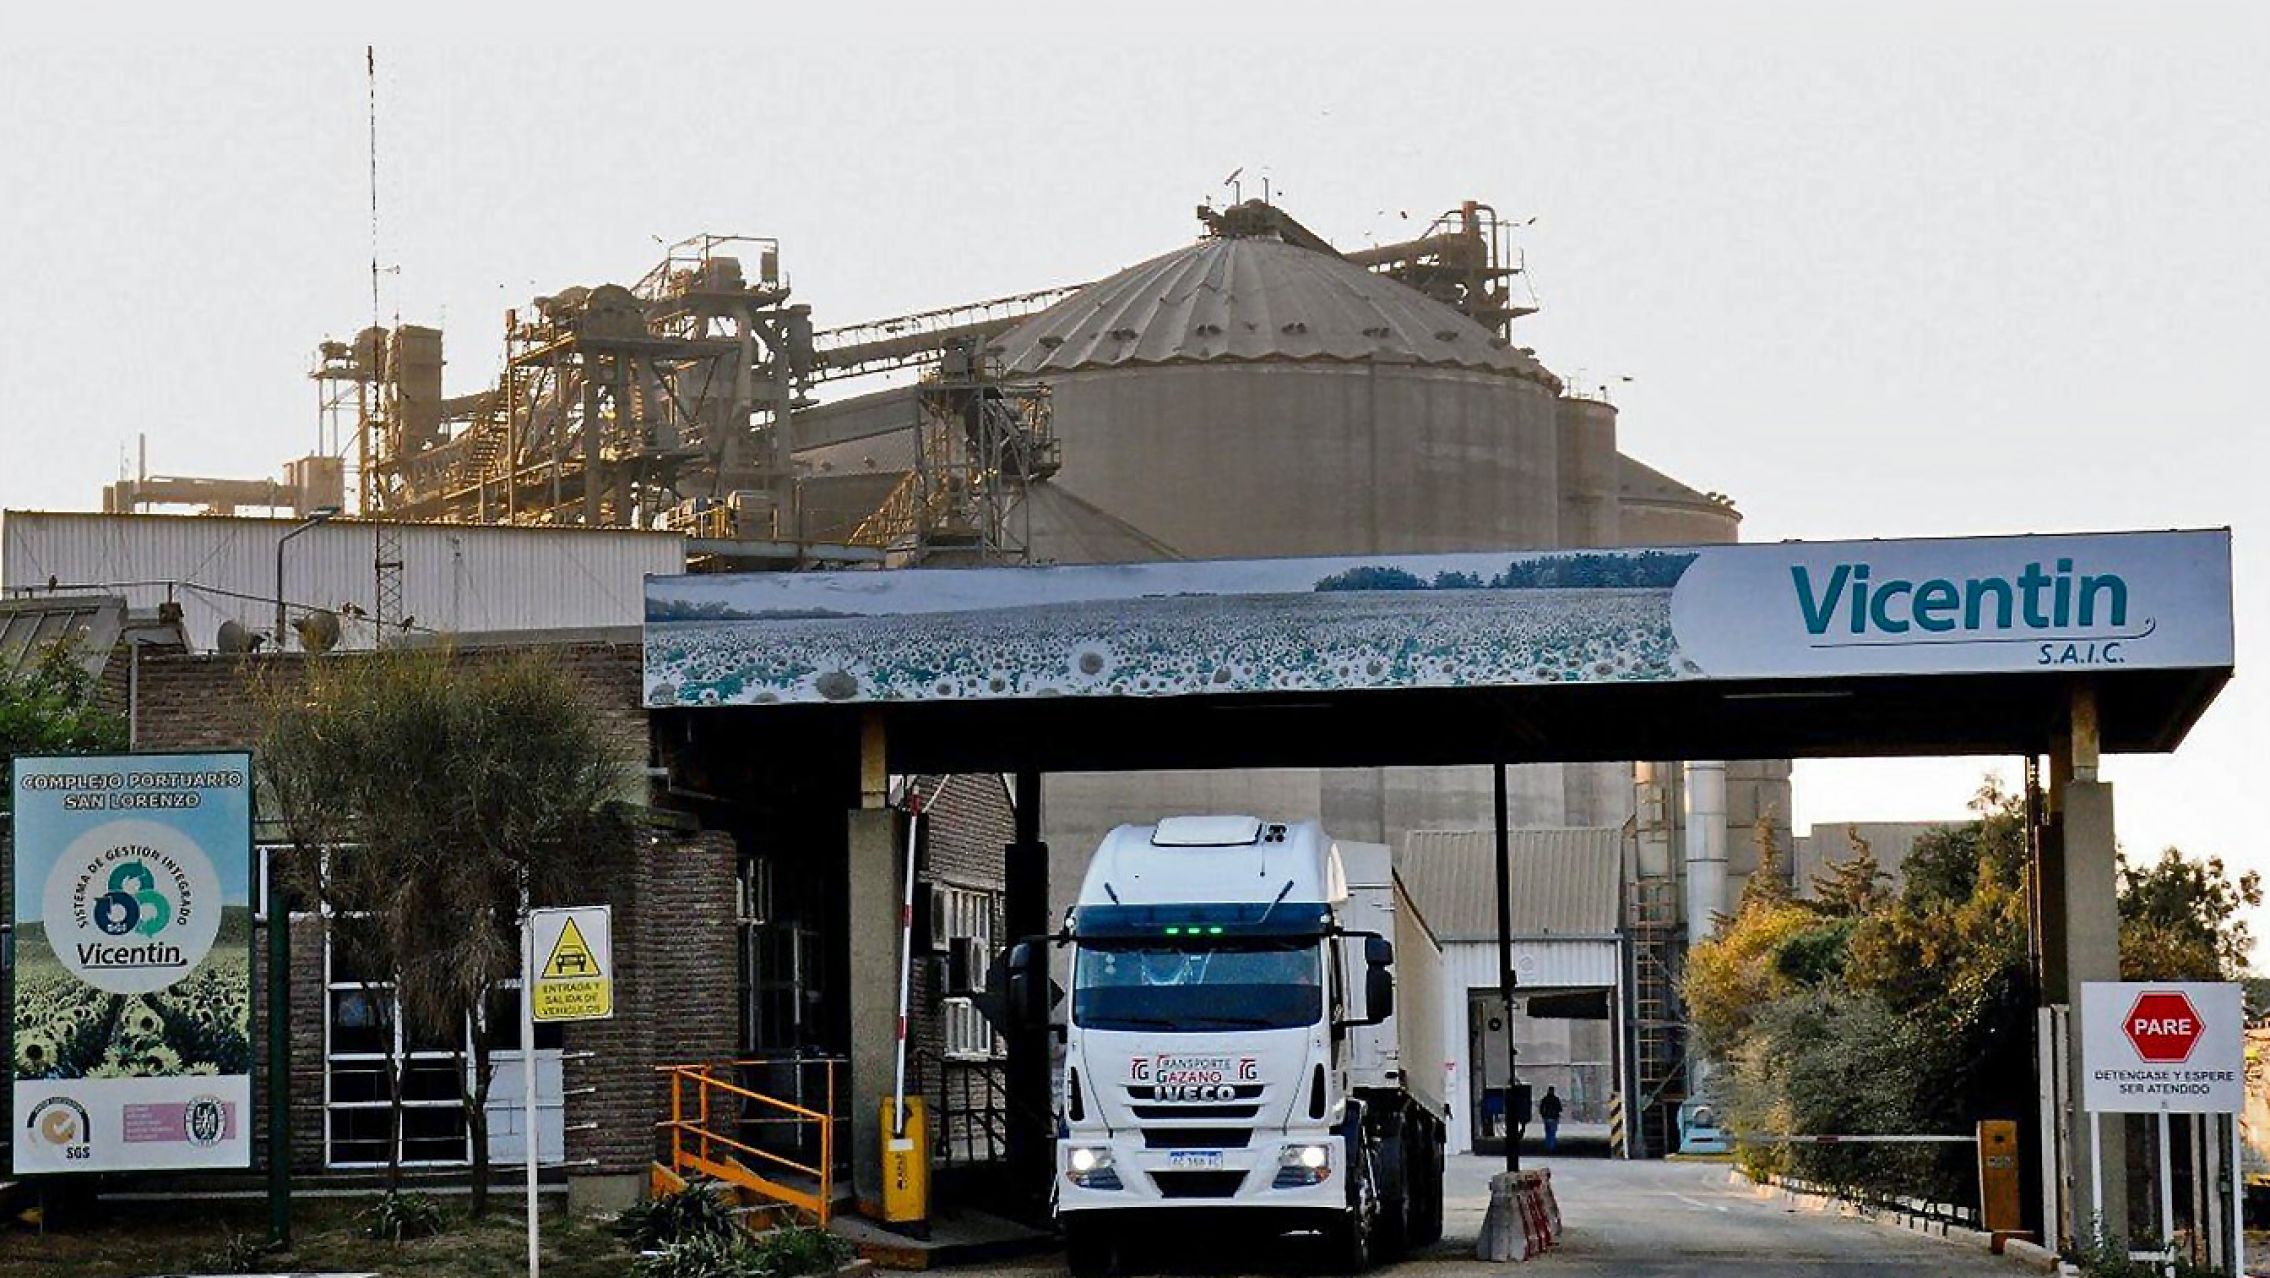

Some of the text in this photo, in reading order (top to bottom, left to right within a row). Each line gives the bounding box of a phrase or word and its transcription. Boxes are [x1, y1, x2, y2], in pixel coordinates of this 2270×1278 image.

[1790, 556, 2128, 635] Vicentin
[2038, 642, 2125, 665] S.A.I.C.
[22, 771, 242, 790] COMPLEJO PORTUARIO
[64, 792, 202, 810] SAN LORENZO
[74, 875, 91, 928] SISTEMA
[88, 858, 103, 873] DE
[161, 857, 191, 926] INTEGRADO
[77, 942, 181, 965] Vicentin
[543, 983, 592, 993] ENTRADA
[545, 994, 583, 1004] SALIDA
[2134, 1018, 2192, 1036] PARE
[1156, 1055, 1232, 1070] TRANSPORTE
[1156, 1069, 1222, 1083] GAZANO
[2095, 1070, 2235, 1081] DETENGASE Y ESPERE
[1154, 1085, 1236, 1102] IVECO
[2119, 1083, 2210, 1095] SER ATENDIDO
[66, 1145, 90, 1159] SGS
